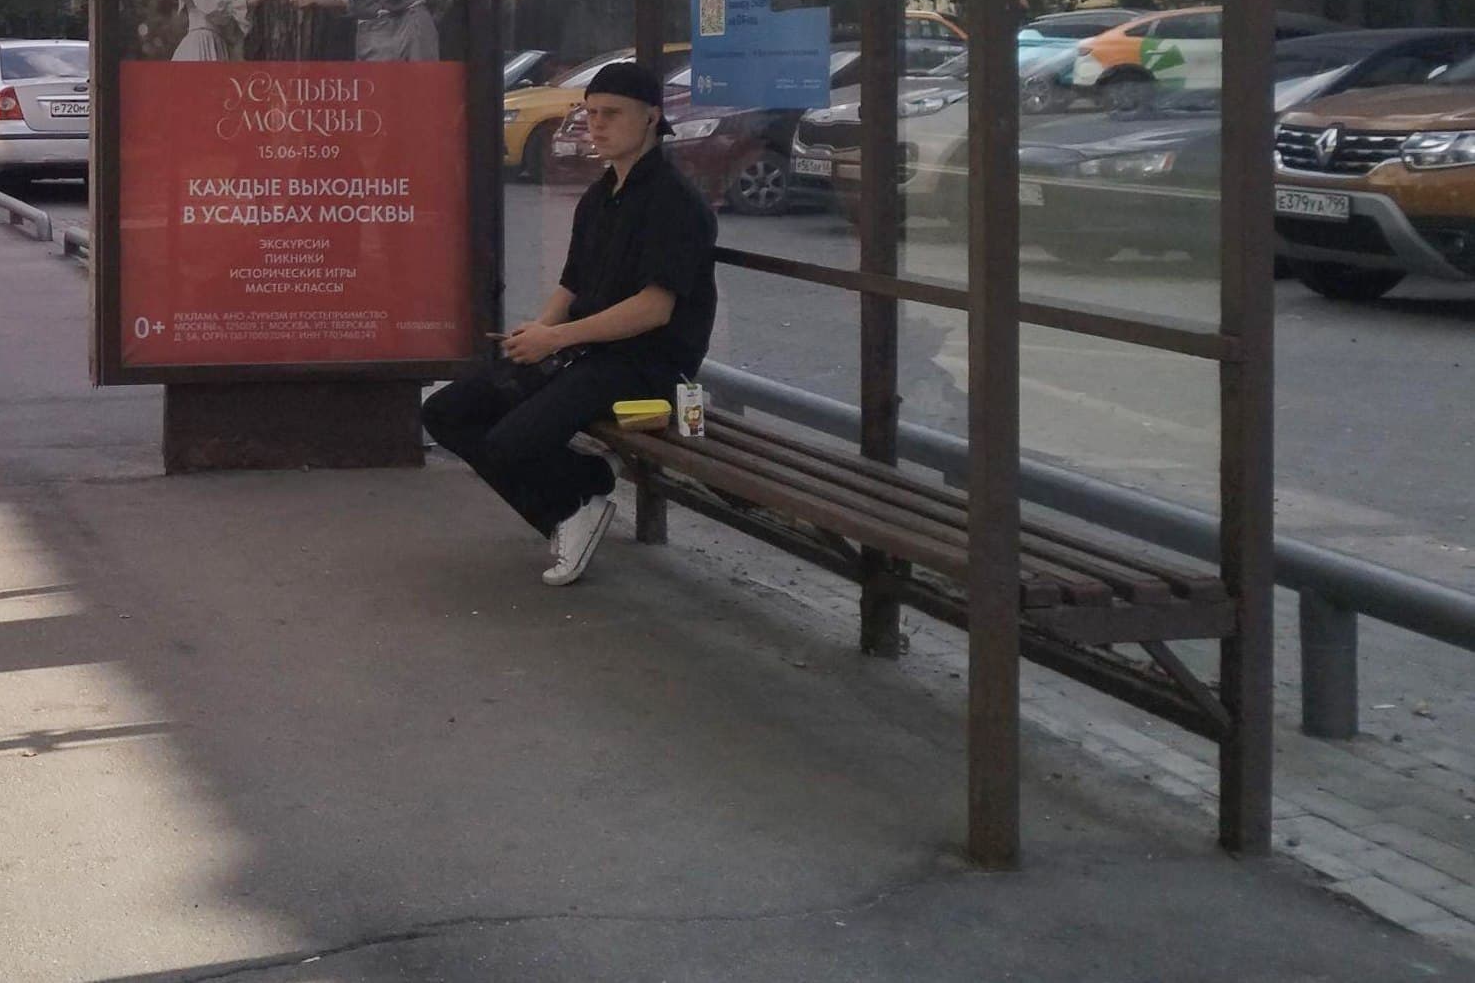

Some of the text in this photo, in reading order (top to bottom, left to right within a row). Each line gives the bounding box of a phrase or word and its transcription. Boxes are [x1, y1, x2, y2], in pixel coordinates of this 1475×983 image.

[223, 71, 375, 110] УСАДЬБЫ
[216, 108, 382, 140] МОСКВЫ
[258, 145, 340, 159] 15.06-15.09
[188, 177, 409, 199] КАЖДЫЕ ВЫХОДНЫЕ
[183, 205, 415, 225] В УСАДЬБАХ МОСКВЫ
[259, 239, 330, 250] ЭКСКУРСИИ
[264, 253, 324, 264] ПИКНИКИ
[230, 268, 357, 279] ИСТОРИЧЕСКИЕ ИГРЫ
[245, 282, 344, 294] МАСТЕР-КЛАССЫ
[134, 316, 166, 339] 0+
